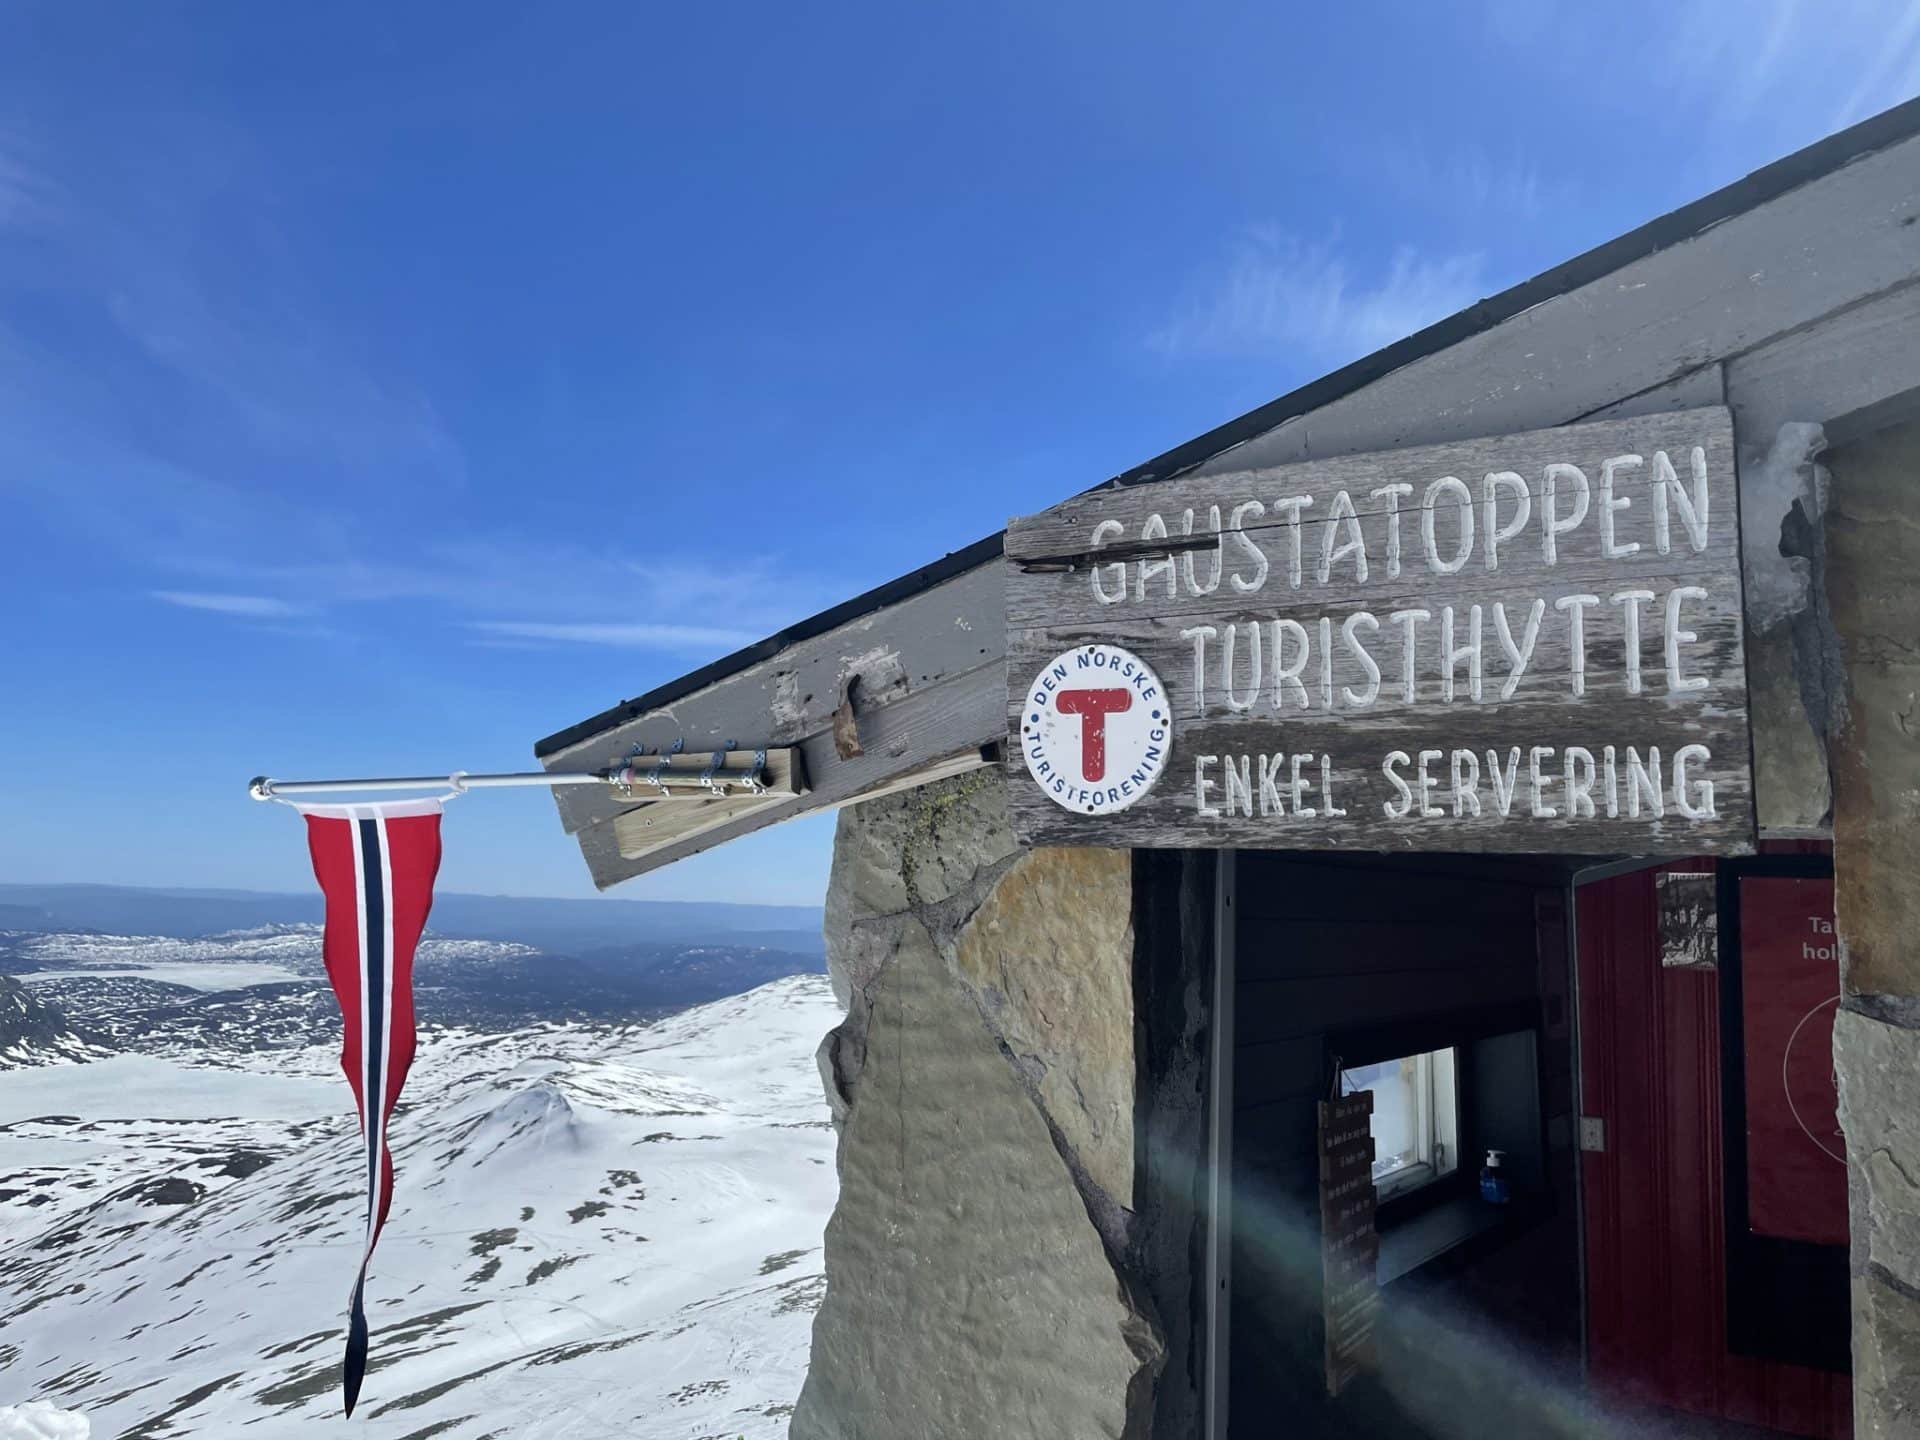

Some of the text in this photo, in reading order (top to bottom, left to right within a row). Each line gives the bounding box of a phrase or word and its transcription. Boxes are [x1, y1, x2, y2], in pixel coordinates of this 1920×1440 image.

[1090, 446, 1710, 605] GAUSTATOPPEN
[1034, 652, 1157, 706] DEN NORSKE
[1179, 585, 1711, 711] TURISTHYTTE
[1028, 729, 1164, 805] TURISTFORENING
[1056, 688, 1132, 782] T
[1194, 744, 1716, 819] ENKEL SERVERING
[1802, 942, 1838, 960] hol
[1808, 916, 1834, 934] Ta
